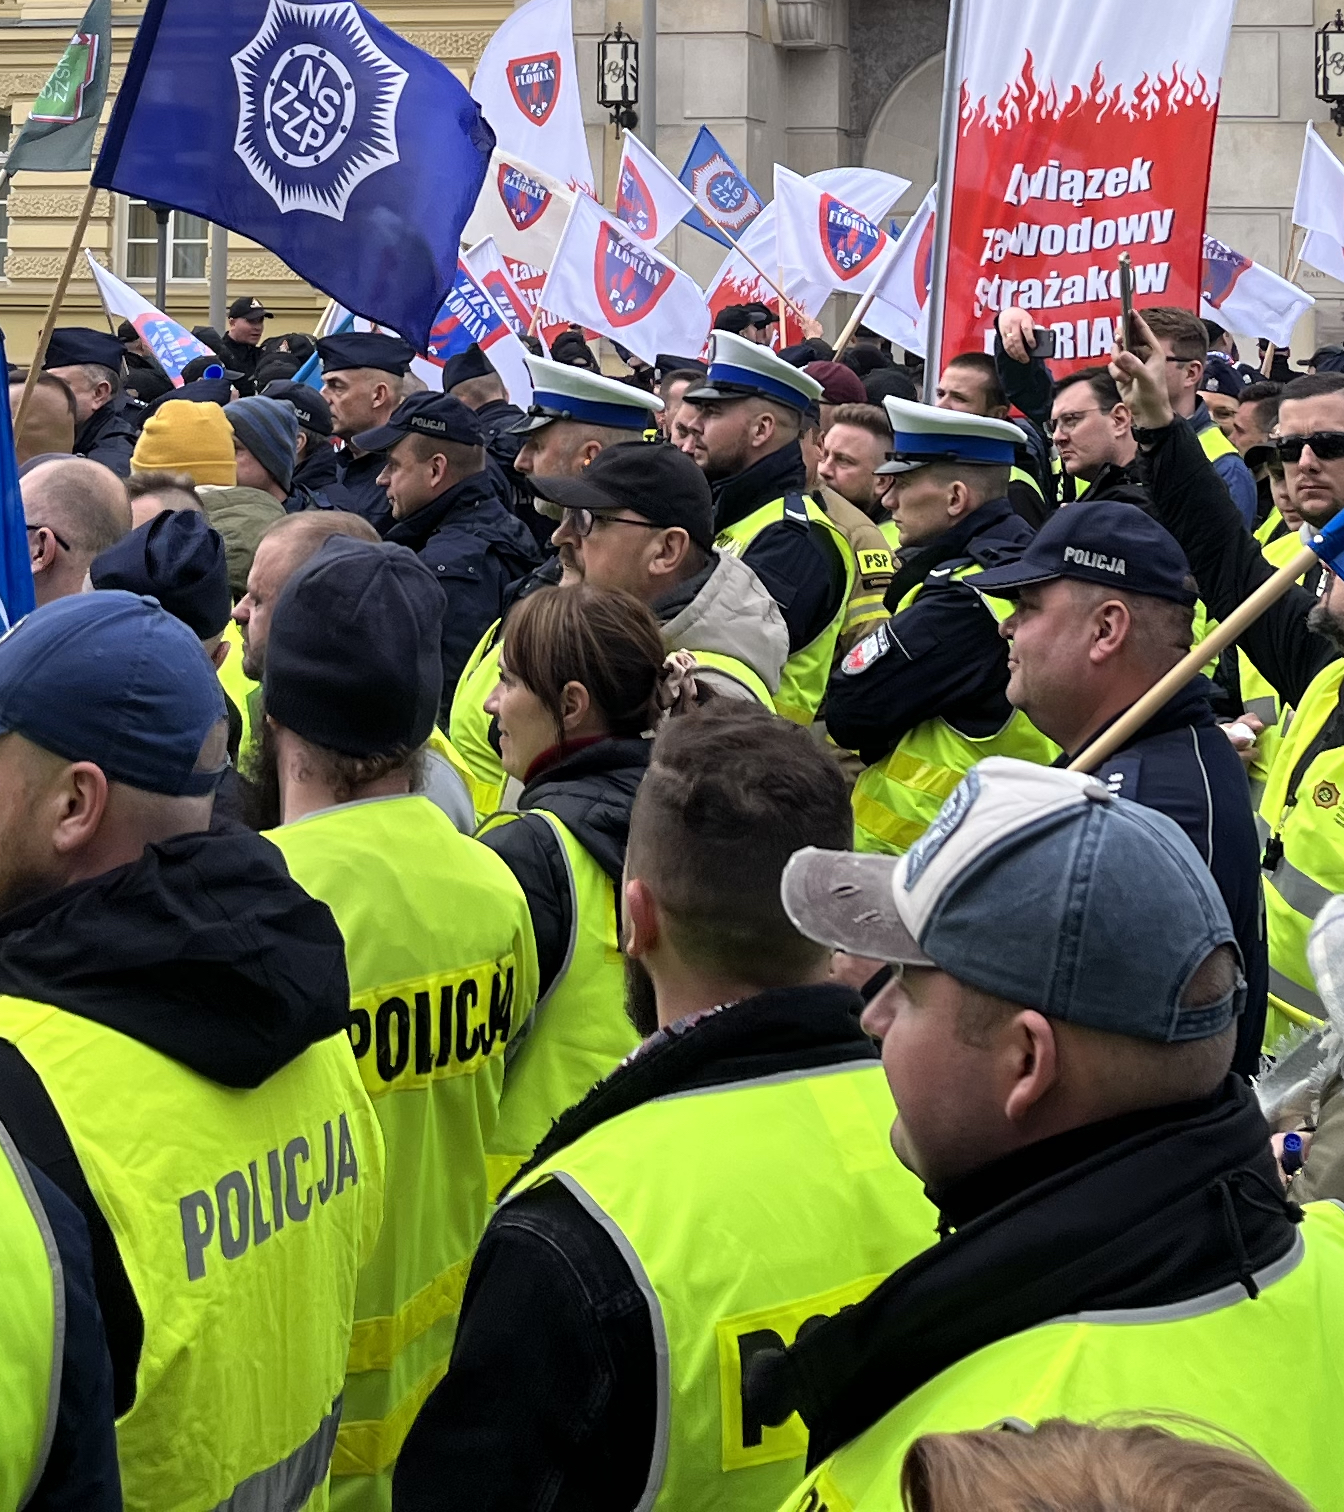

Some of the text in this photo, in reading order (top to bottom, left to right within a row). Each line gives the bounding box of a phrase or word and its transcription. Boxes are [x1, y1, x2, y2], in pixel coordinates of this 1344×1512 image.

[979, 208, 1175, 266] zawodowy
[607, 239, 663, 287] FLORIAN
[837, 249, 862, 269] PSP
[445, 288, 491, 345] LORIAN
[458, 278, 496, 320] ZZS
[609, 288, 637, 316] PSP
[411, 416, 446, 432] POLICJA
[863, 553, 889, 569] PSP
[1064, 546, 1126, 576] POLICJA
[179, 1110, 358, 1282] POLICJA
